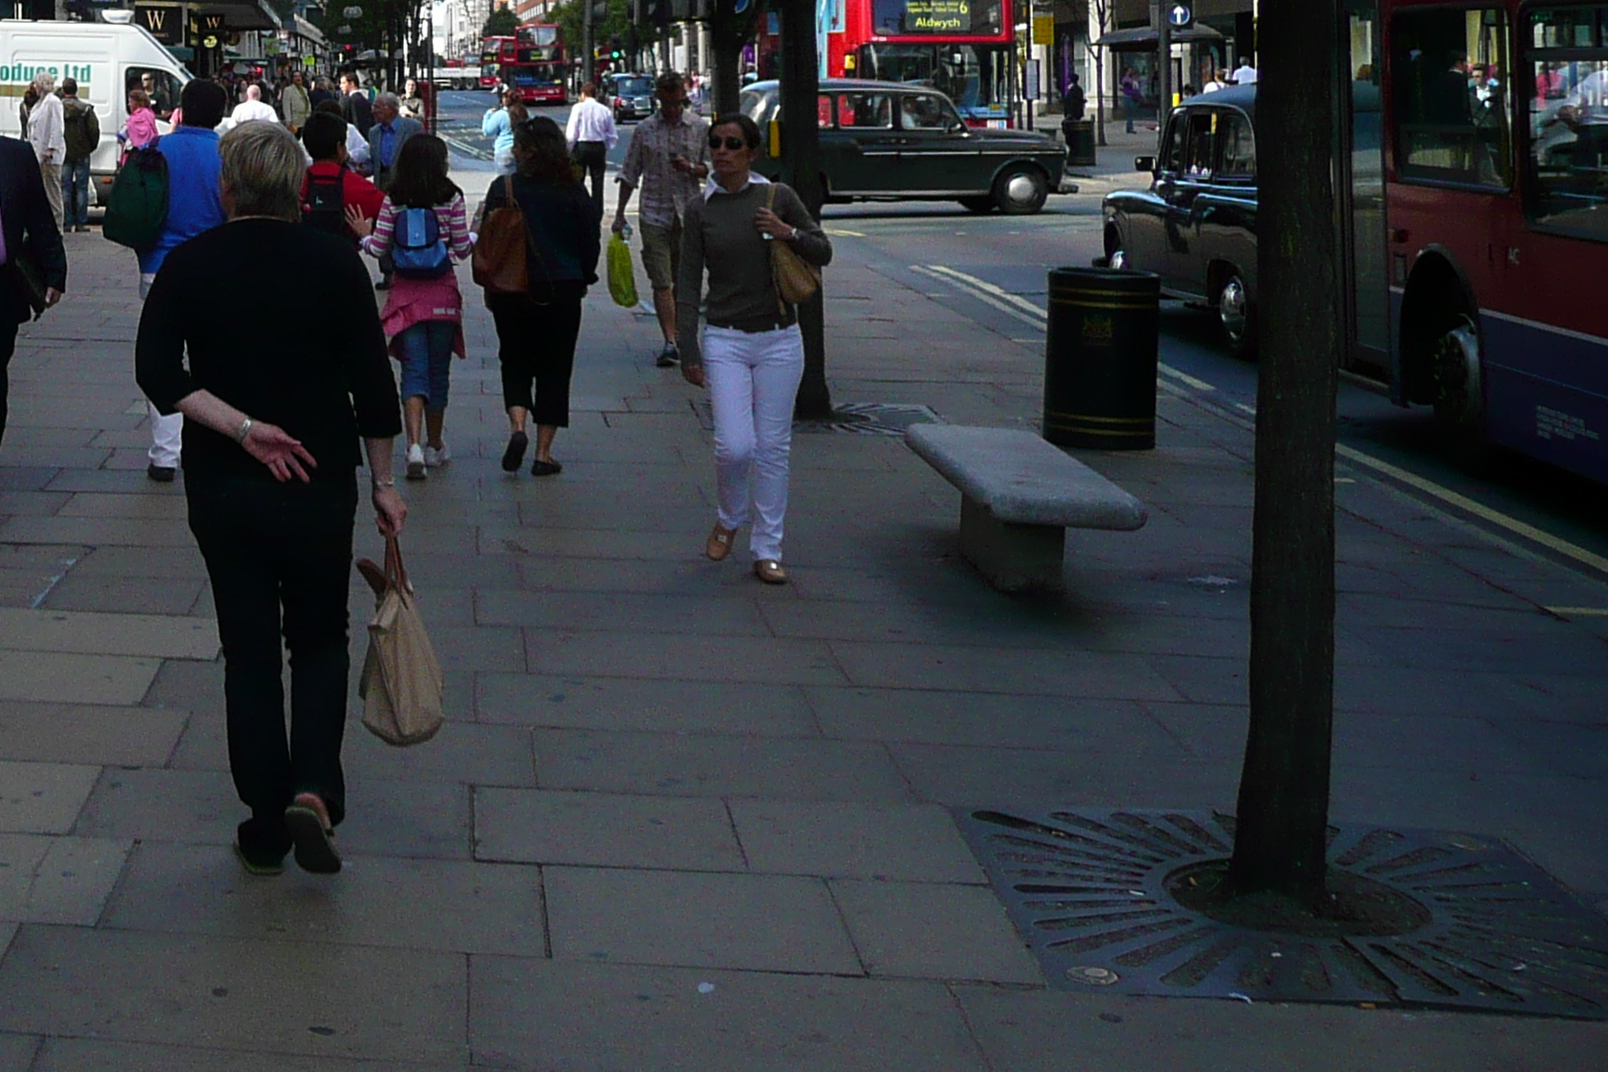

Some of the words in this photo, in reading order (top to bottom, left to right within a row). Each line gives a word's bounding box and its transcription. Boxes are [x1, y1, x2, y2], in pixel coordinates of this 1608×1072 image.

[959, 0, 968, 14] 6
[146, 10, 166, 32] W
[205, 16, 221, 30] W
[915, 16, 961, 30] Aldwych
[64, 63, 91, 83] Ltd
